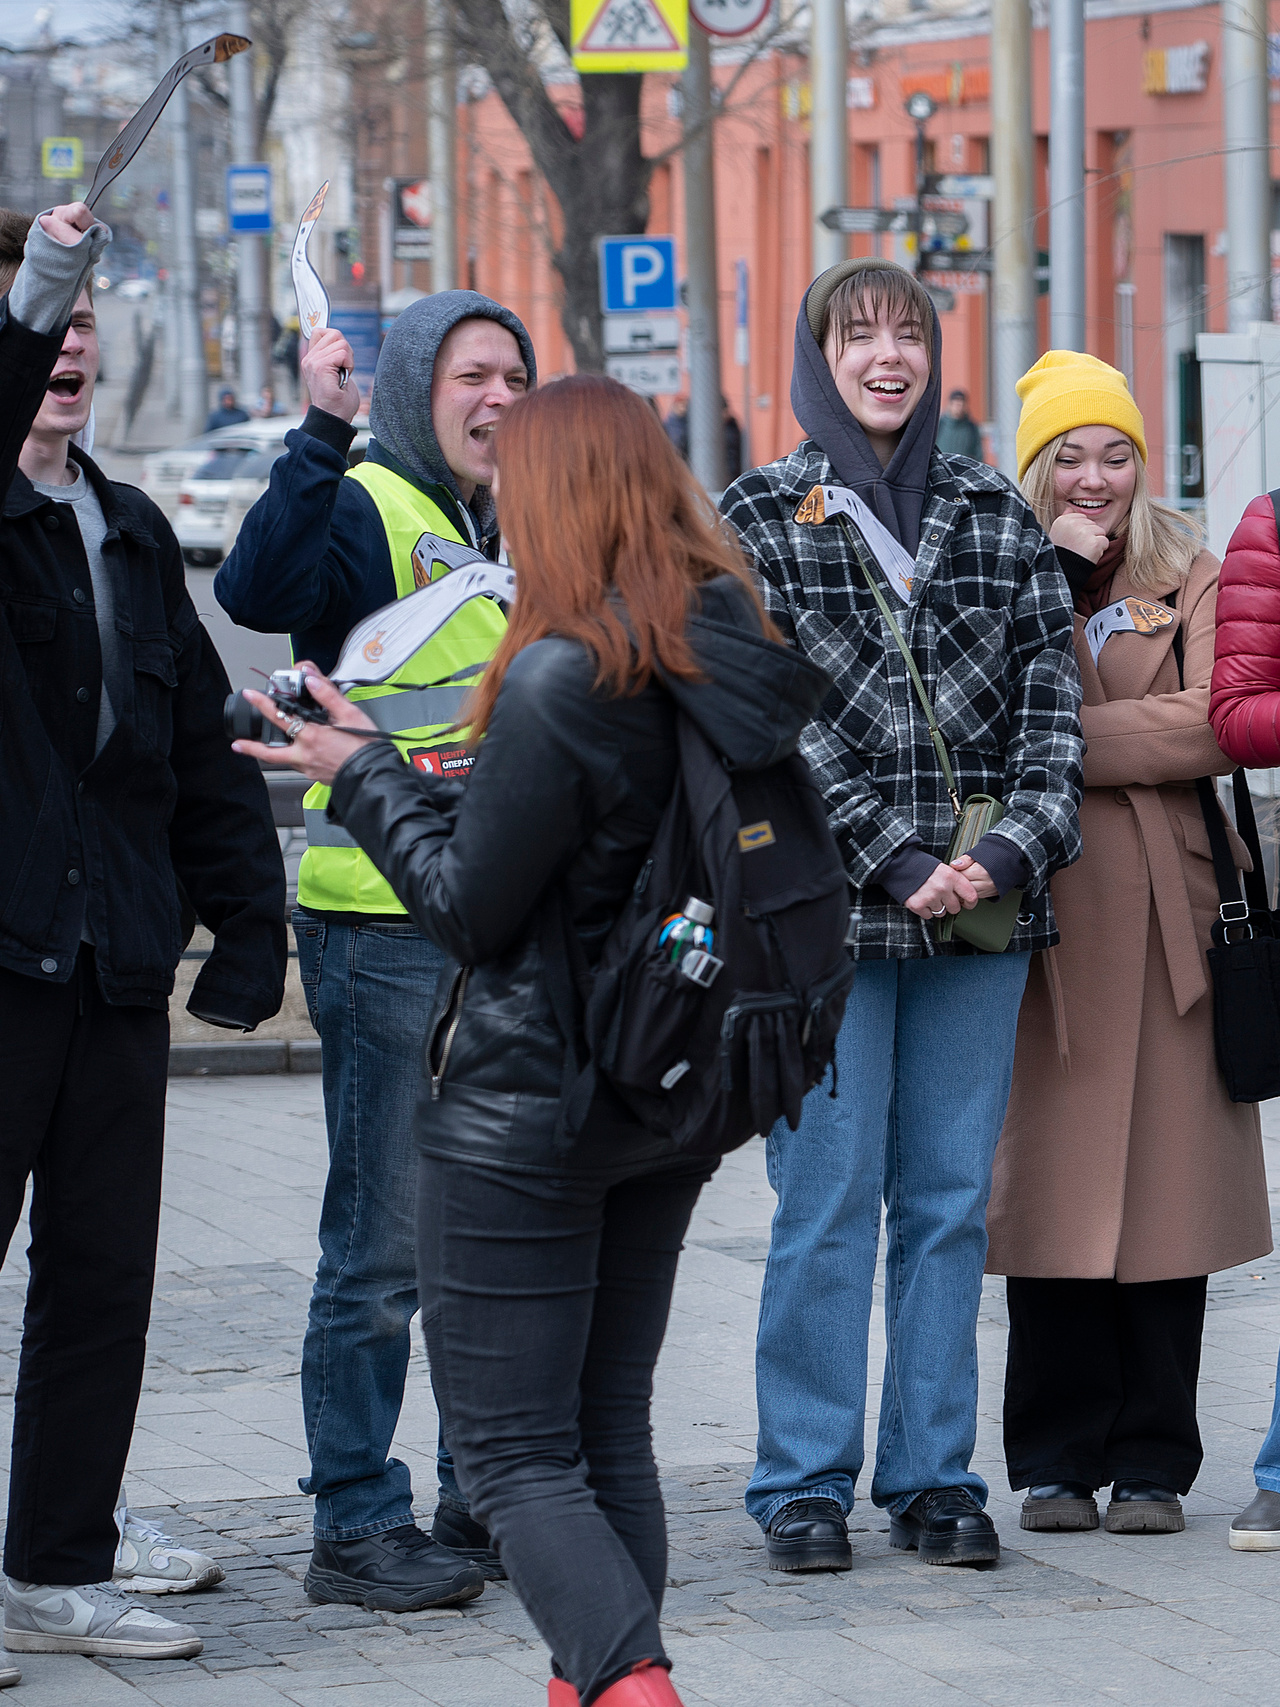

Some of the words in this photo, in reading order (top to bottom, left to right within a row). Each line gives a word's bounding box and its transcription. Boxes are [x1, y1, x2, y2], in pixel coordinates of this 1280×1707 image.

[621, 244, 665, 307] P
[440, 749, 467, 760] ЦЕНТР
[442, 757, 476, 769] ОПЕРАТ
[444, 768, 473, 778] ПЕЧАТ
